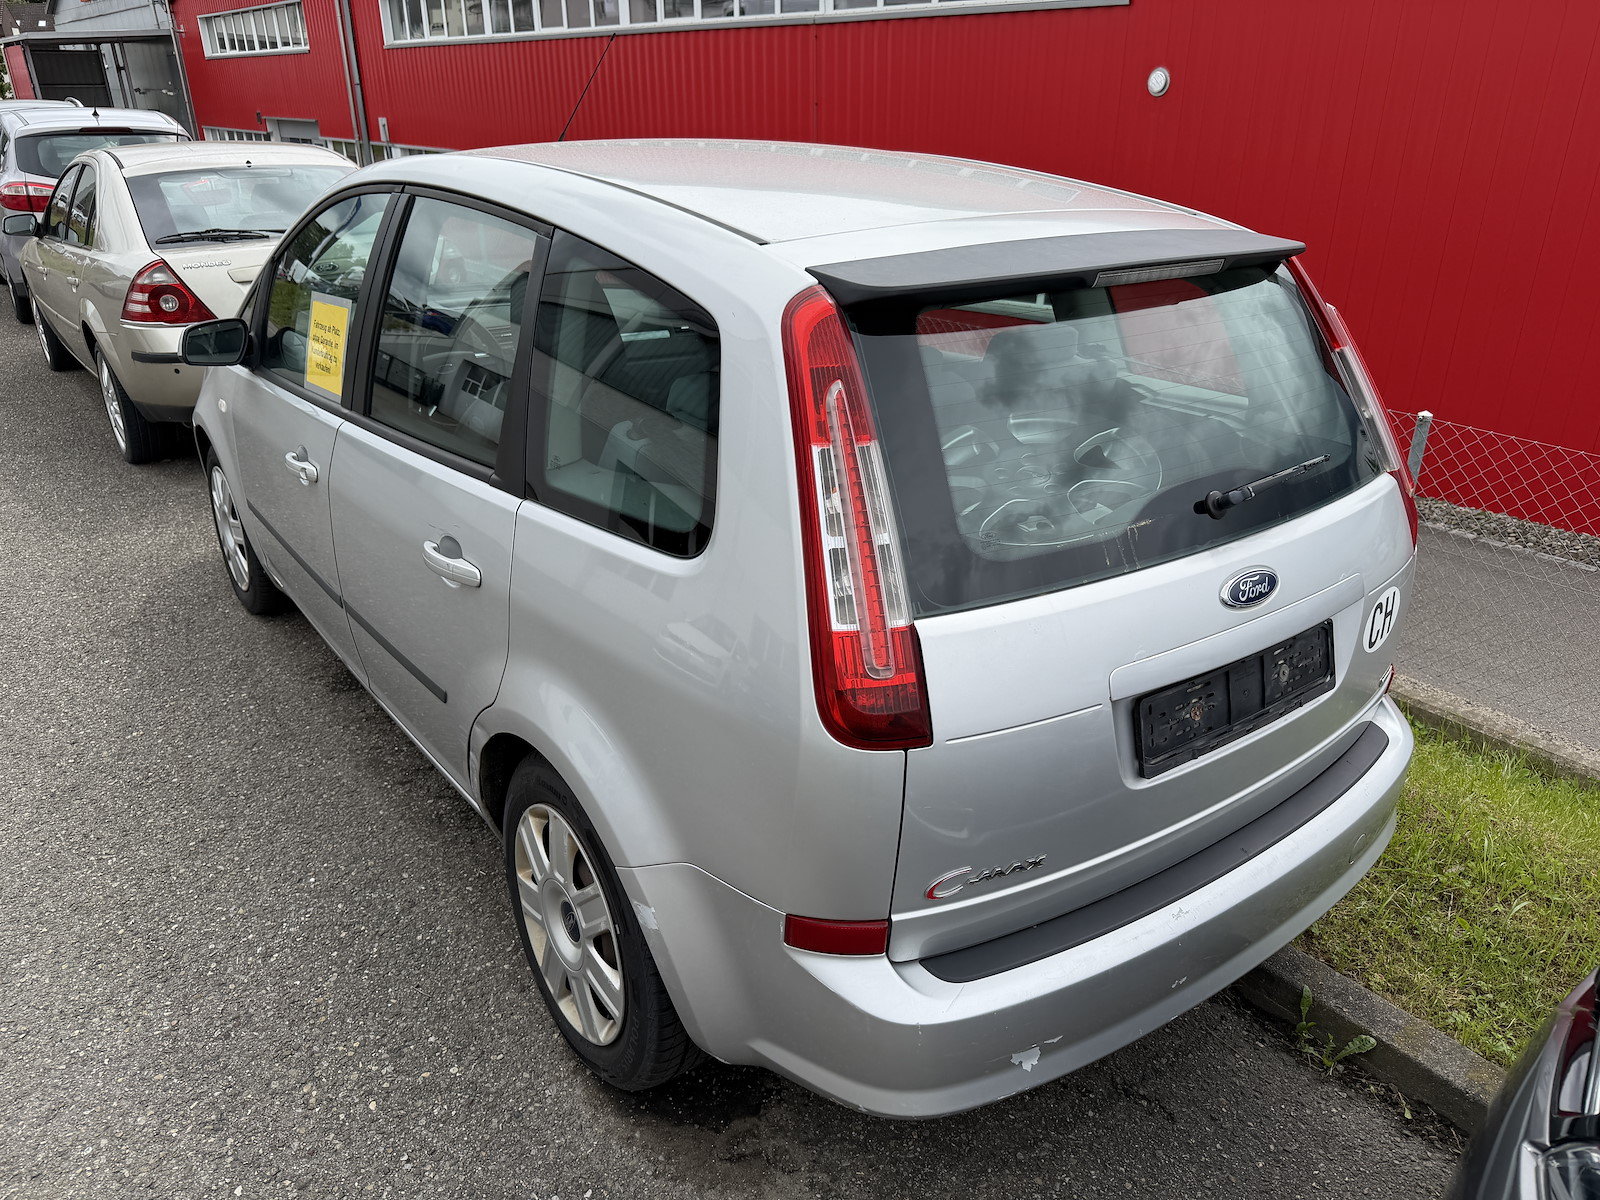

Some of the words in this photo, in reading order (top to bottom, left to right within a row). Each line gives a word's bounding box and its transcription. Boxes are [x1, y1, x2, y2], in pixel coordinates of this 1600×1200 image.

[182, 259, 232, 270] MONDEO
[1238, 574, 1270, 602] Ford
[1368, 590, 1396, 650] CH
